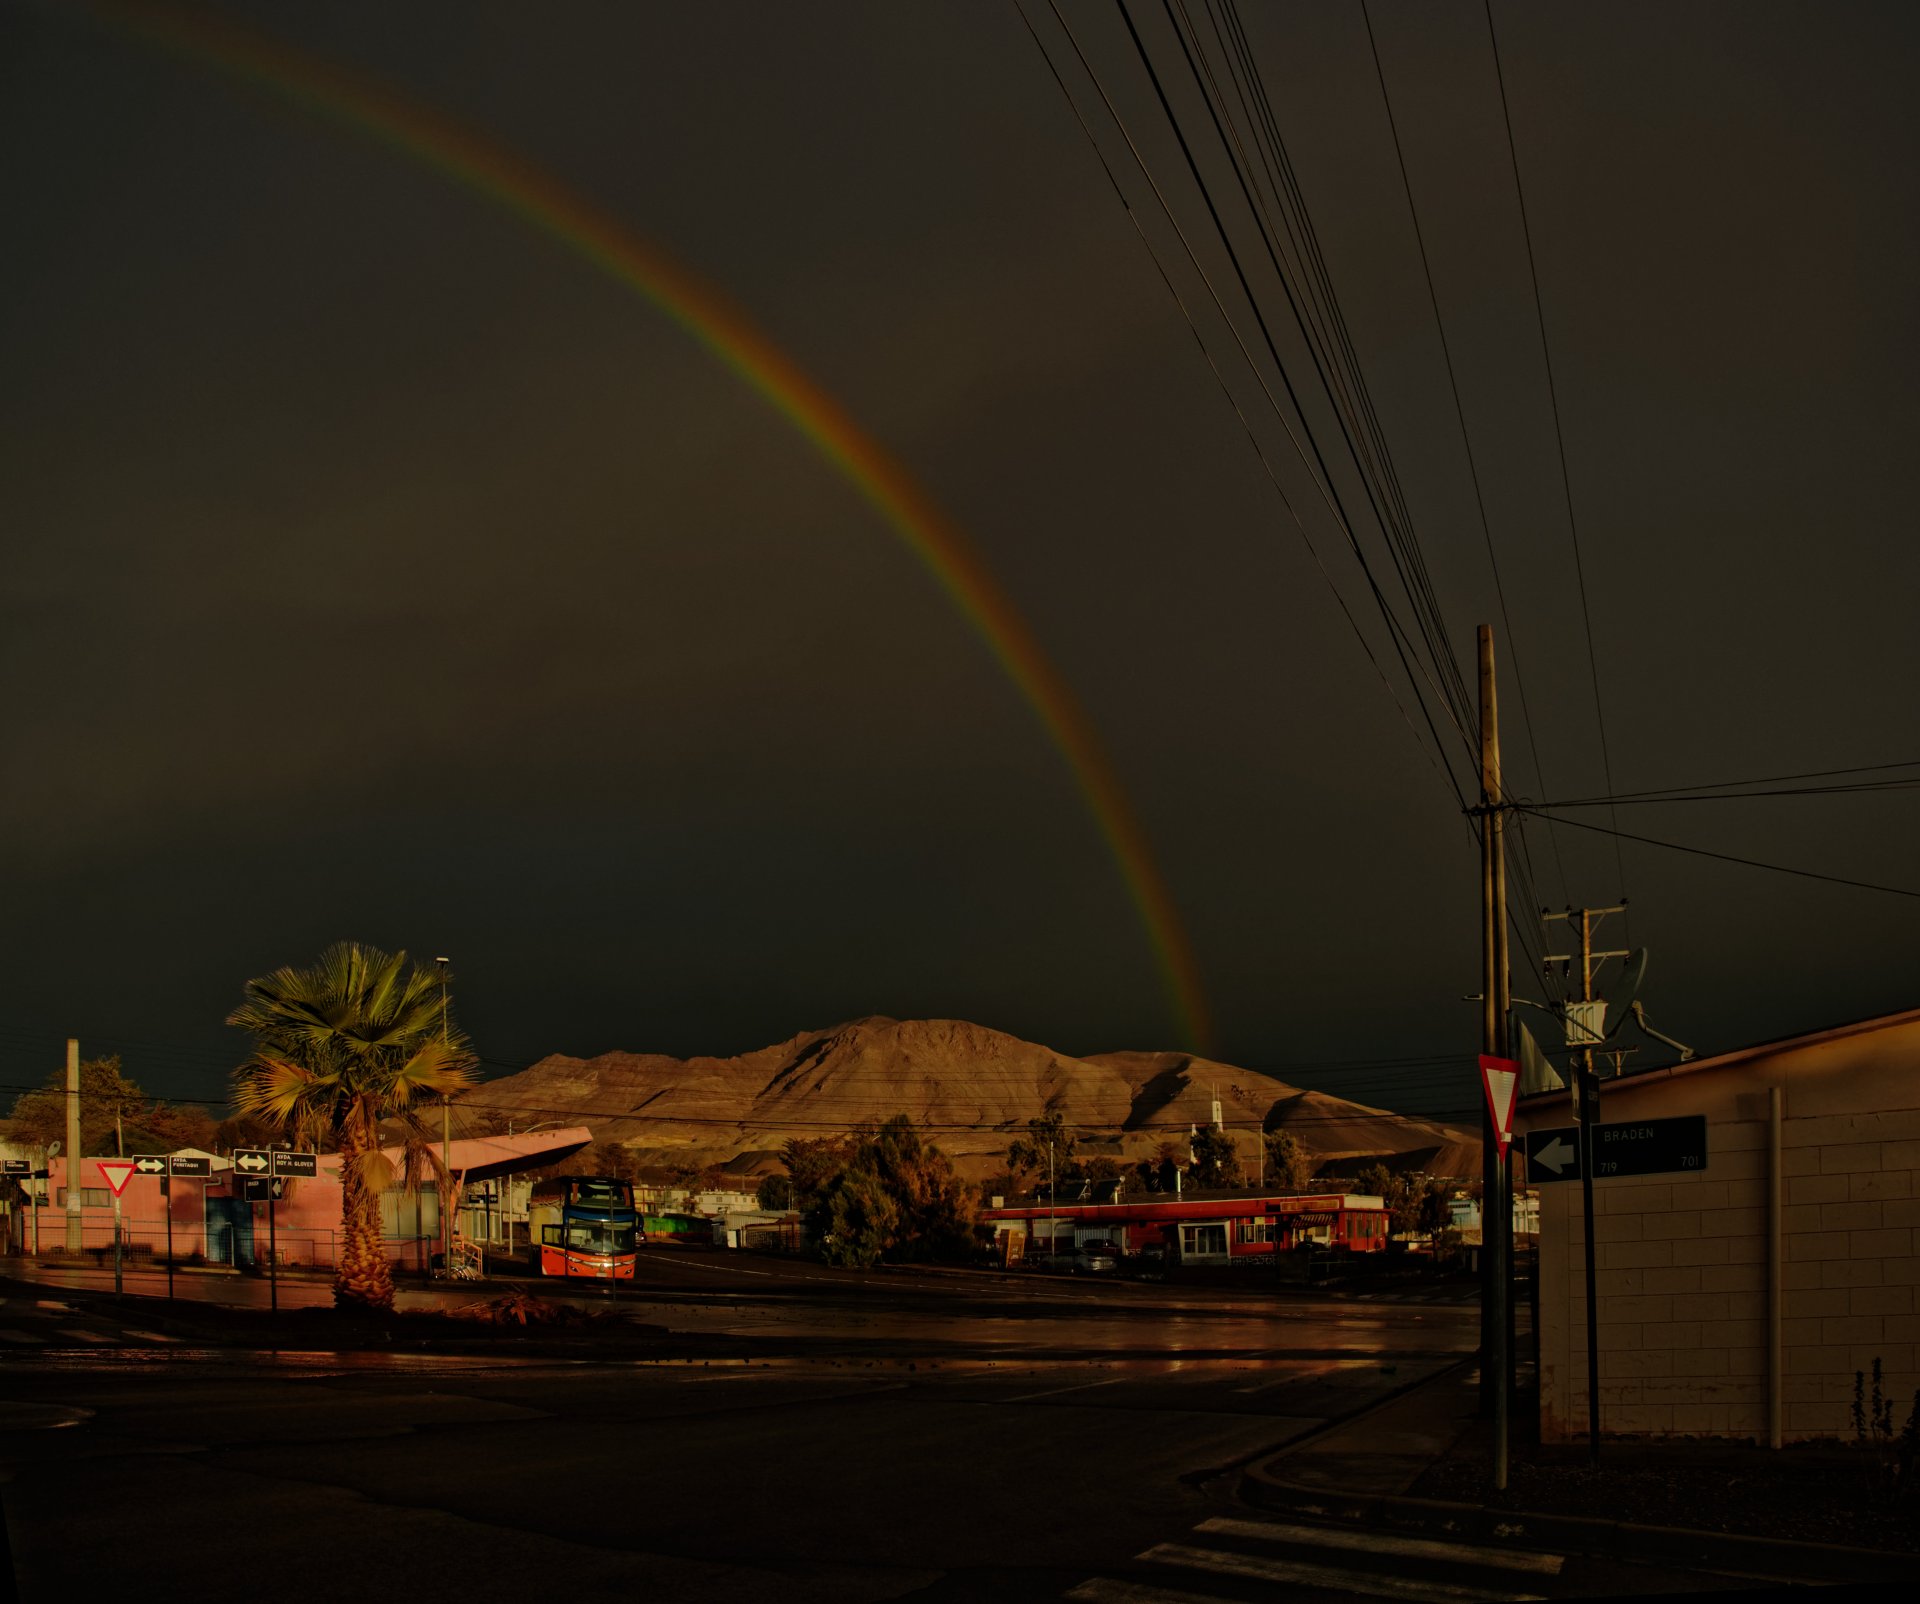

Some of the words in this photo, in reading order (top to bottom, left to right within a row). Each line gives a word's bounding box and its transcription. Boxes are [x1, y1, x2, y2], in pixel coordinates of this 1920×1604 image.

[1604, 1128, 1654, 1142] BRADEN
[1600, 1162, 1618, 1173] 719
[1681, 1155, 1699, 1168] 701
